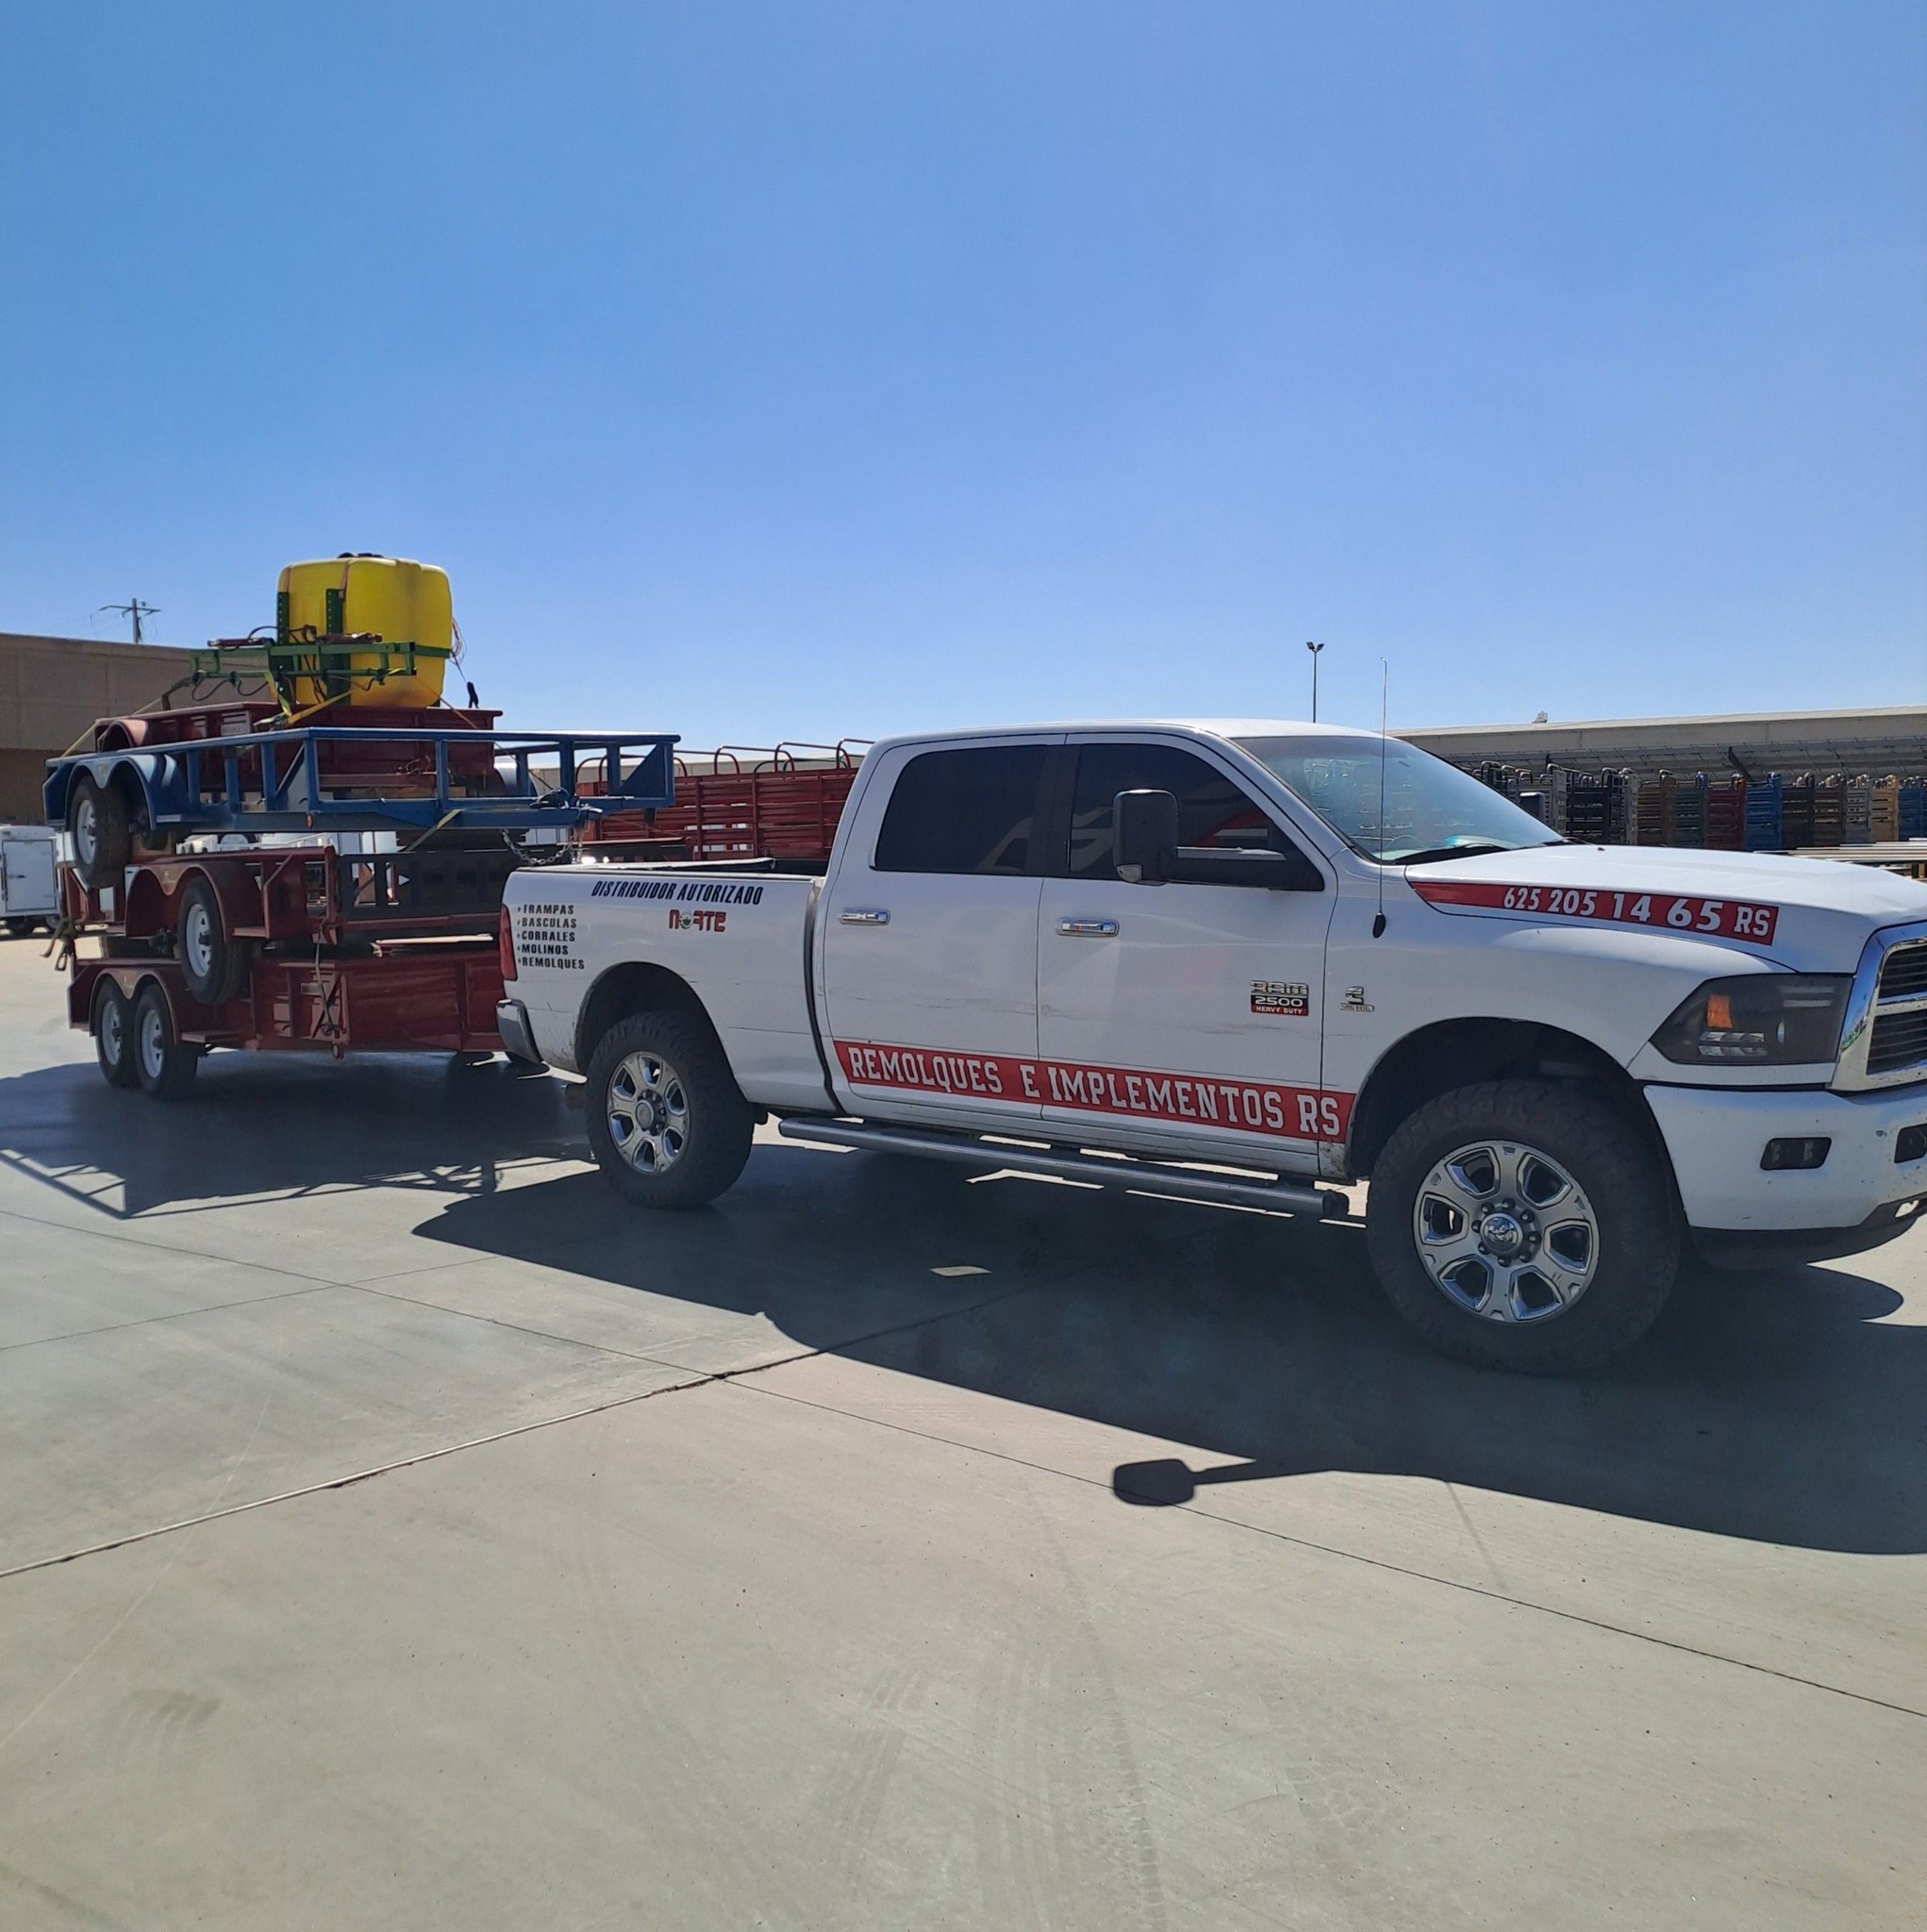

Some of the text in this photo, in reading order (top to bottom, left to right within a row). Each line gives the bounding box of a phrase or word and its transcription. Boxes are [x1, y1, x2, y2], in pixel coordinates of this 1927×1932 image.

[591, 880, 764, 906] DISTRIBUIDOR AUTORIZADO
[1503, 887, 1771, 937] 625 205 14 65 RS
[522, 917, 577, 928] BASCULAS
[522, 930, 575, 941] CORRALES
[522, 943, 569, 956] MOLINOS
[522, 957, 585, 970] REMOLQUES
[1254, 995, 1304, 1008] 2500
[1255, 1006, 1304, 1015] HEAVY DUTY
[848, 1046, 1340, 1136] REMOLQUES E IMPLEMENTOS RS
